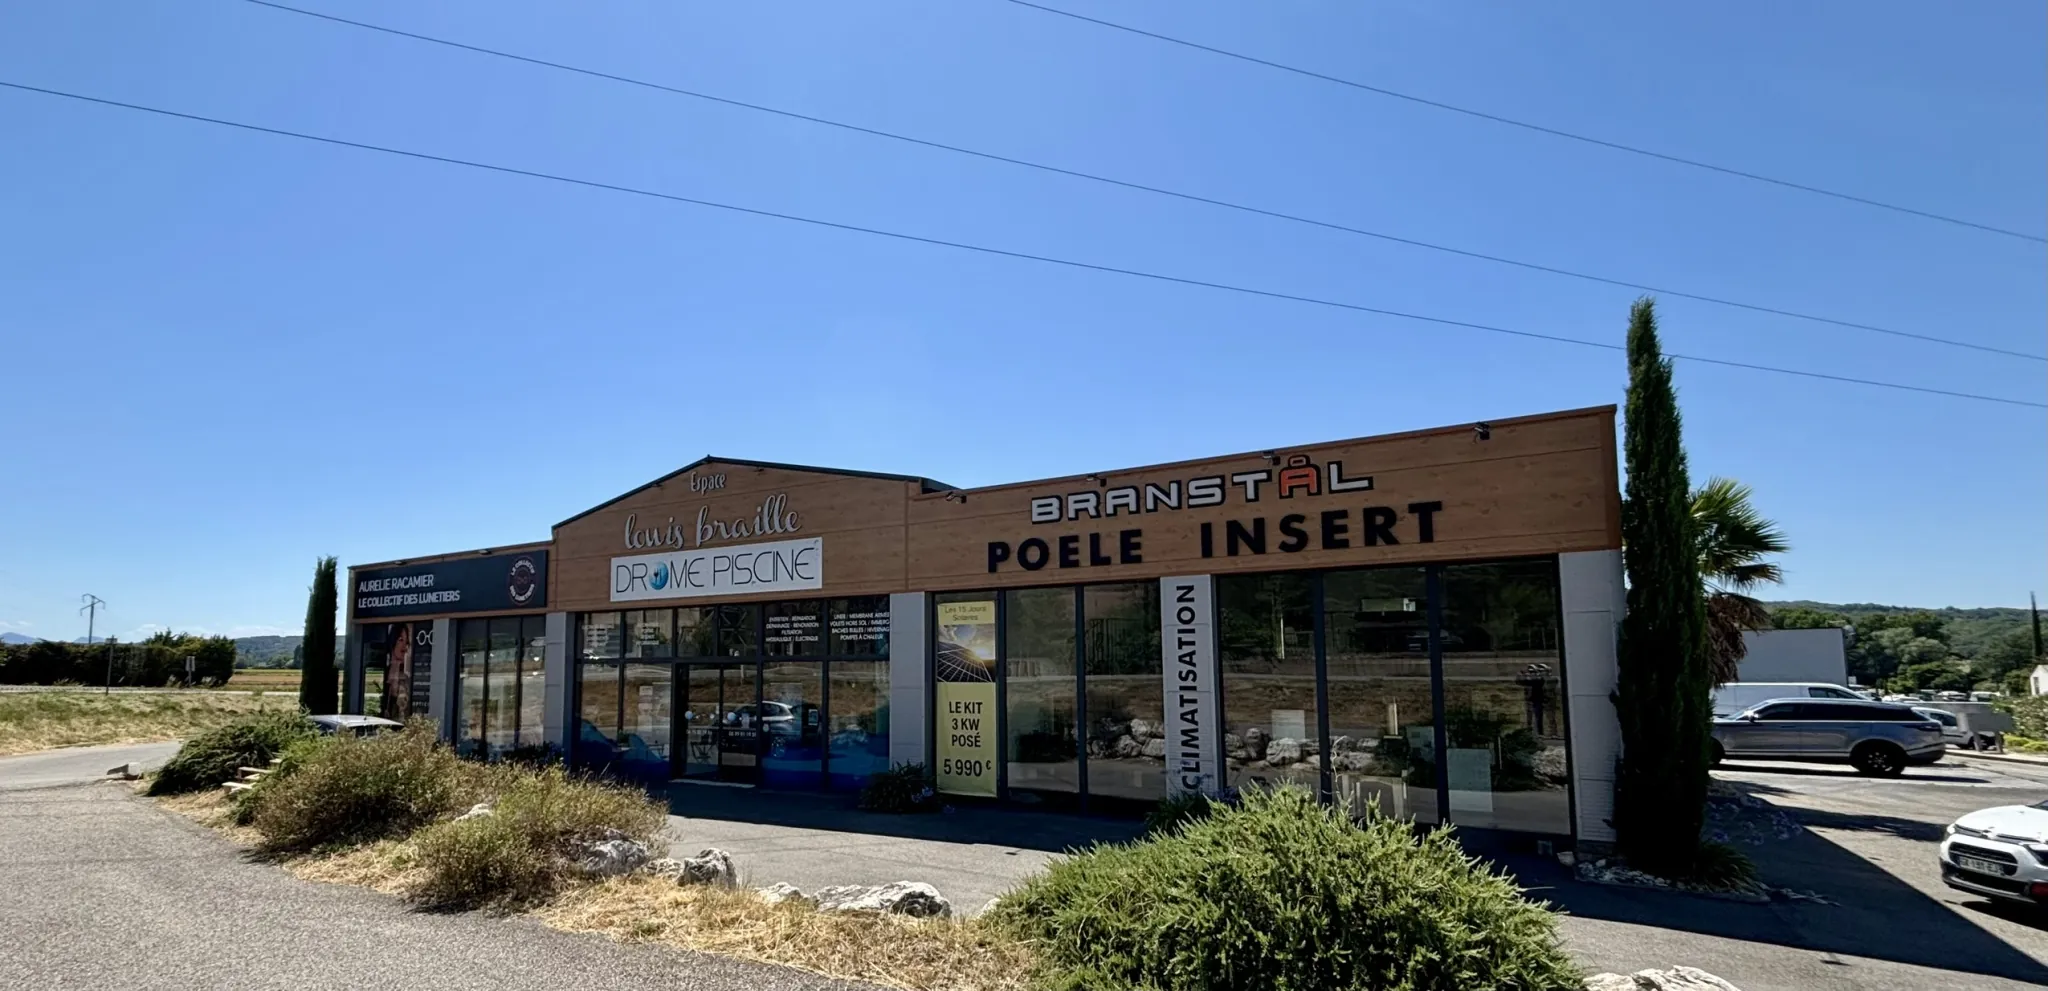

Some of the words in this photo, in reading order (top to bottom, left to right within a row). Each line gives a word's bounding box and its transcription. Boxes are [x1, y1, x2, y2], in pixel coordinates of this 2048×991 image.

[690, 471, 726, 495] Espace
[1031, 455, 1374, 524] BRANSTÅL
[624, 513, 684, 549] louis
[696, 493, 802, 547] braille
[988, 529, 1142, 573] POELE
[1200, 501, 1442, 558] INSERT
[712, 547, 815, 586] PISCINE
[359, 578, 392, 593] AURELIE
[391, 574, 434, 590] RACAMIER
[358, 598, 367, 609] LE
[367, 594, 404, 608] COLLECTIF
[404, 593, 418, 605] DES
[419, 590, 460, 604] LUNETIERS
[944, 605, 957, 614] Les
[957, 605, 967, 613] 15
[968, 604, 987, 613] Jours
[1176, 585, 1201, 789] CLIMATISATION
[949, 702, 961, 714] LE
[964, 701, 983, 714] KIT
[952, 718, 959, 731] 3
[960, 718, 980, 731] KW
[951, 732, 981, 748] POSÉ
[943, 759, 951, 775] 5
[955, 760, 983, 777] 990
[985, 760, 992, 771] €
